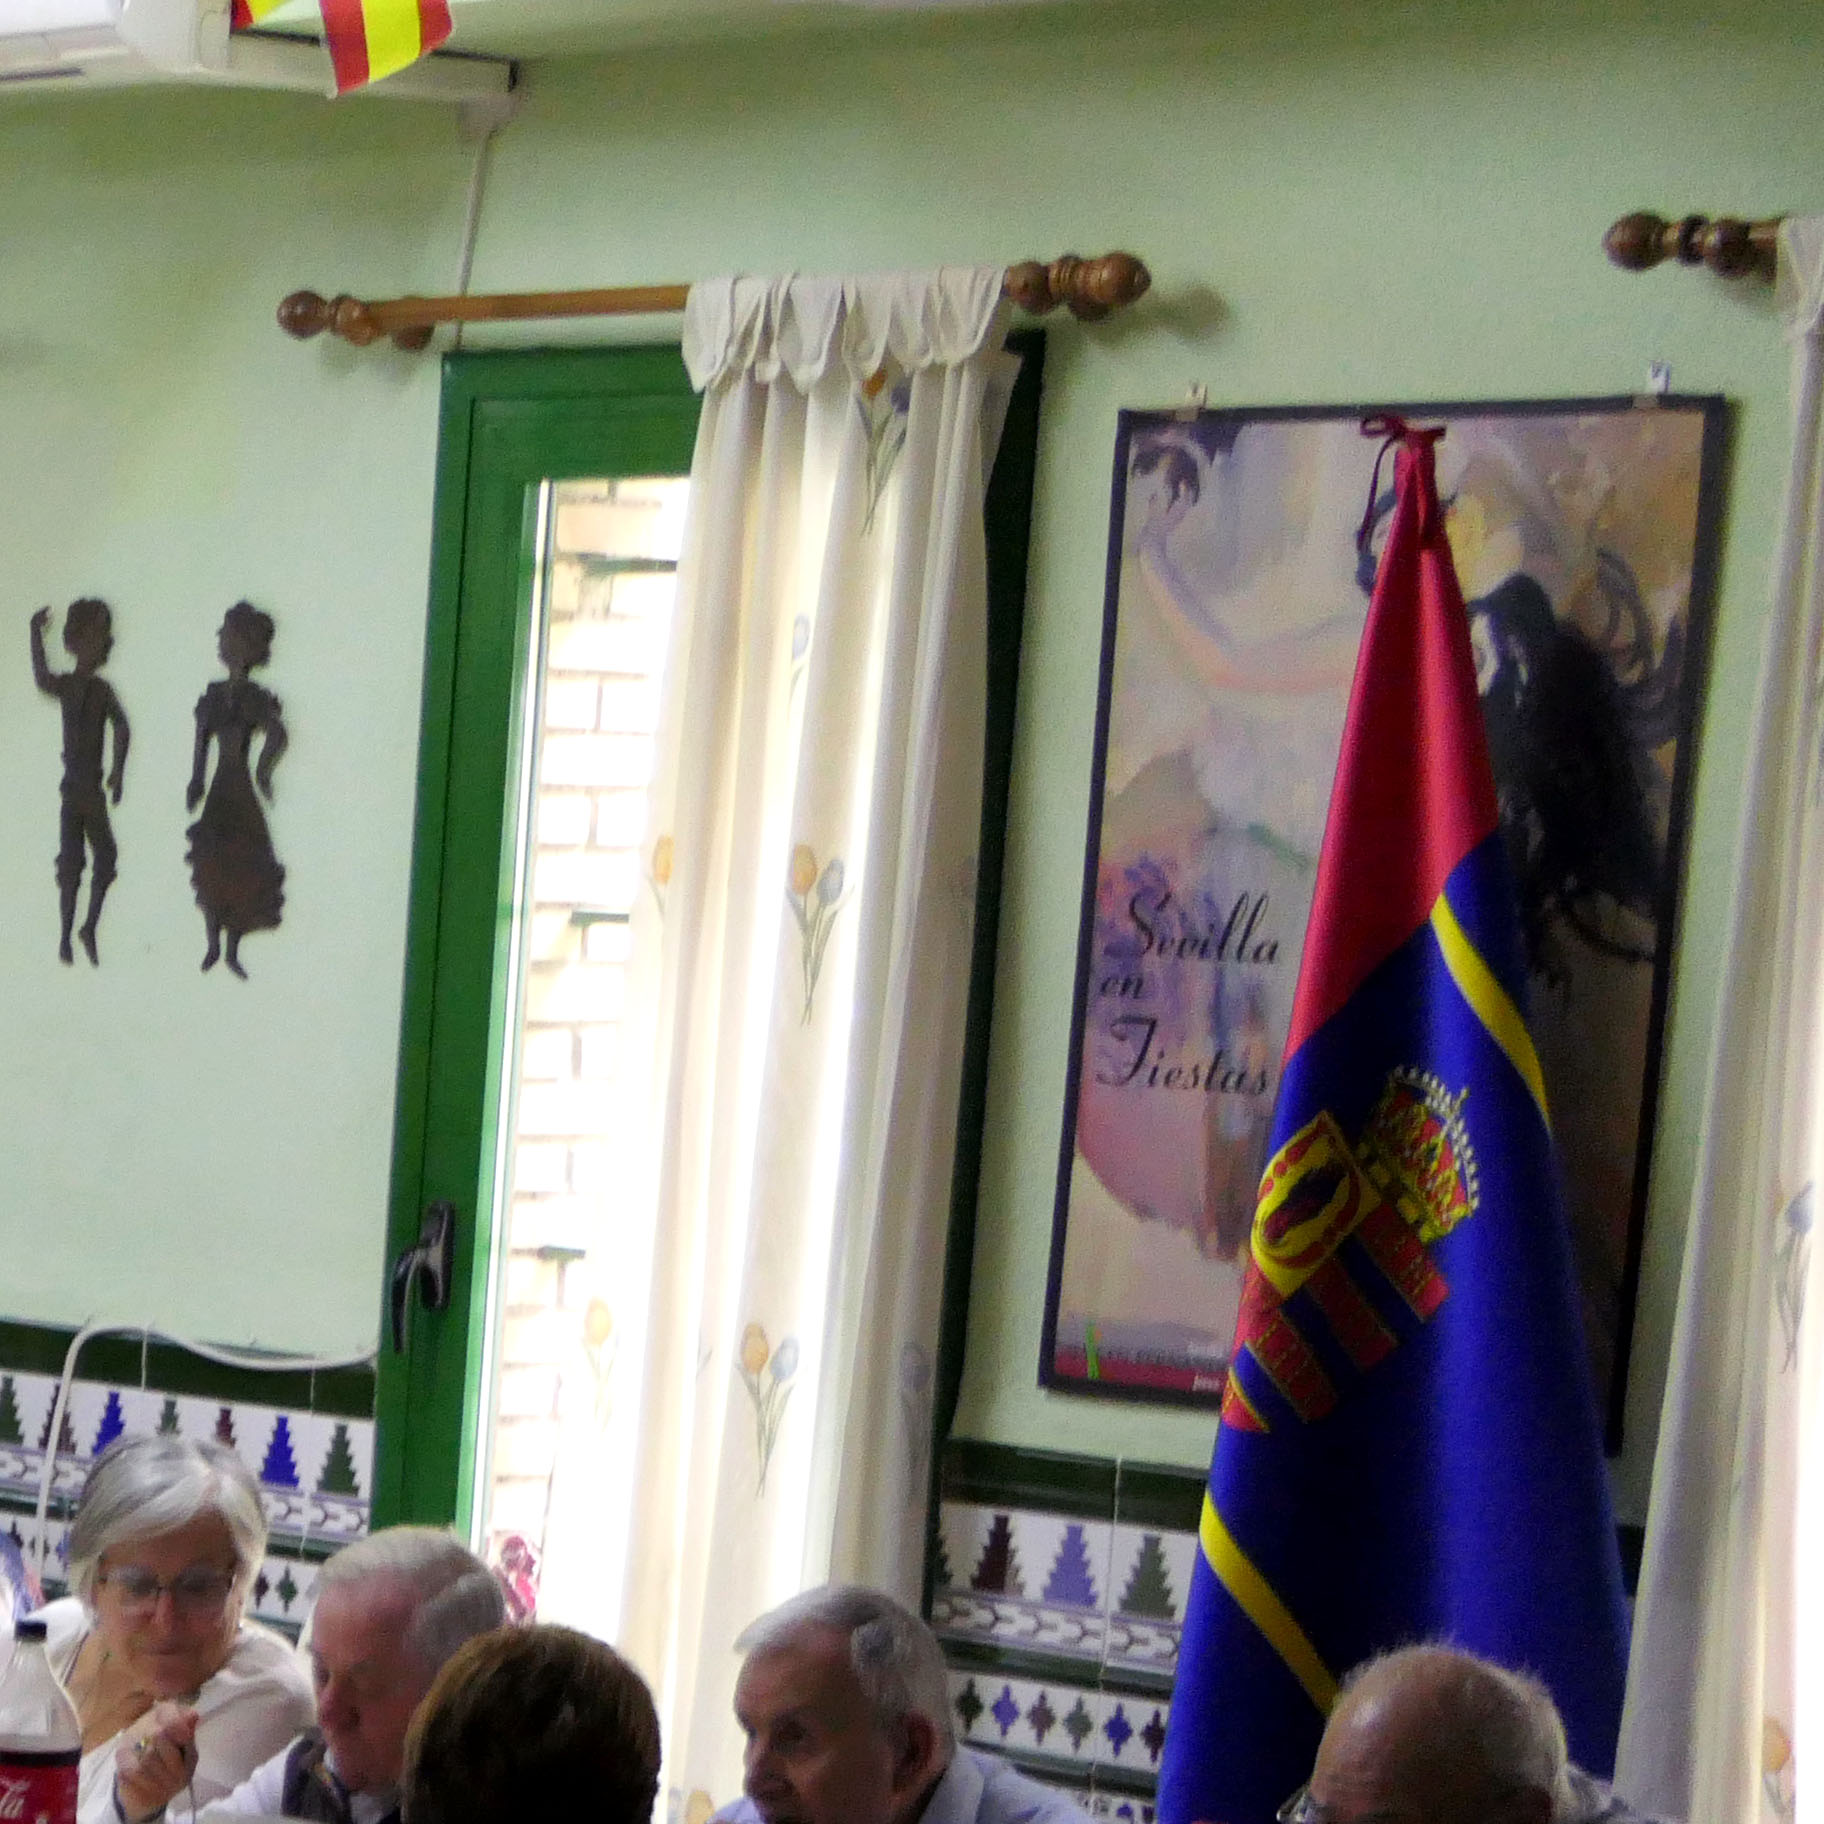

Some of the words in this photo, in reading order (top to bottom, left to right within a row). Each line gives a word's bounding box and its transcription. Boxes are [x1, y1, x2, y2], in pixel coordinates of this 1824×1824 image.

[1129, 891, 1278, 963] Sevilla
[1101, 975, 1144, 999] en
[1095, 1014, 1267, 1096] Fiestas
